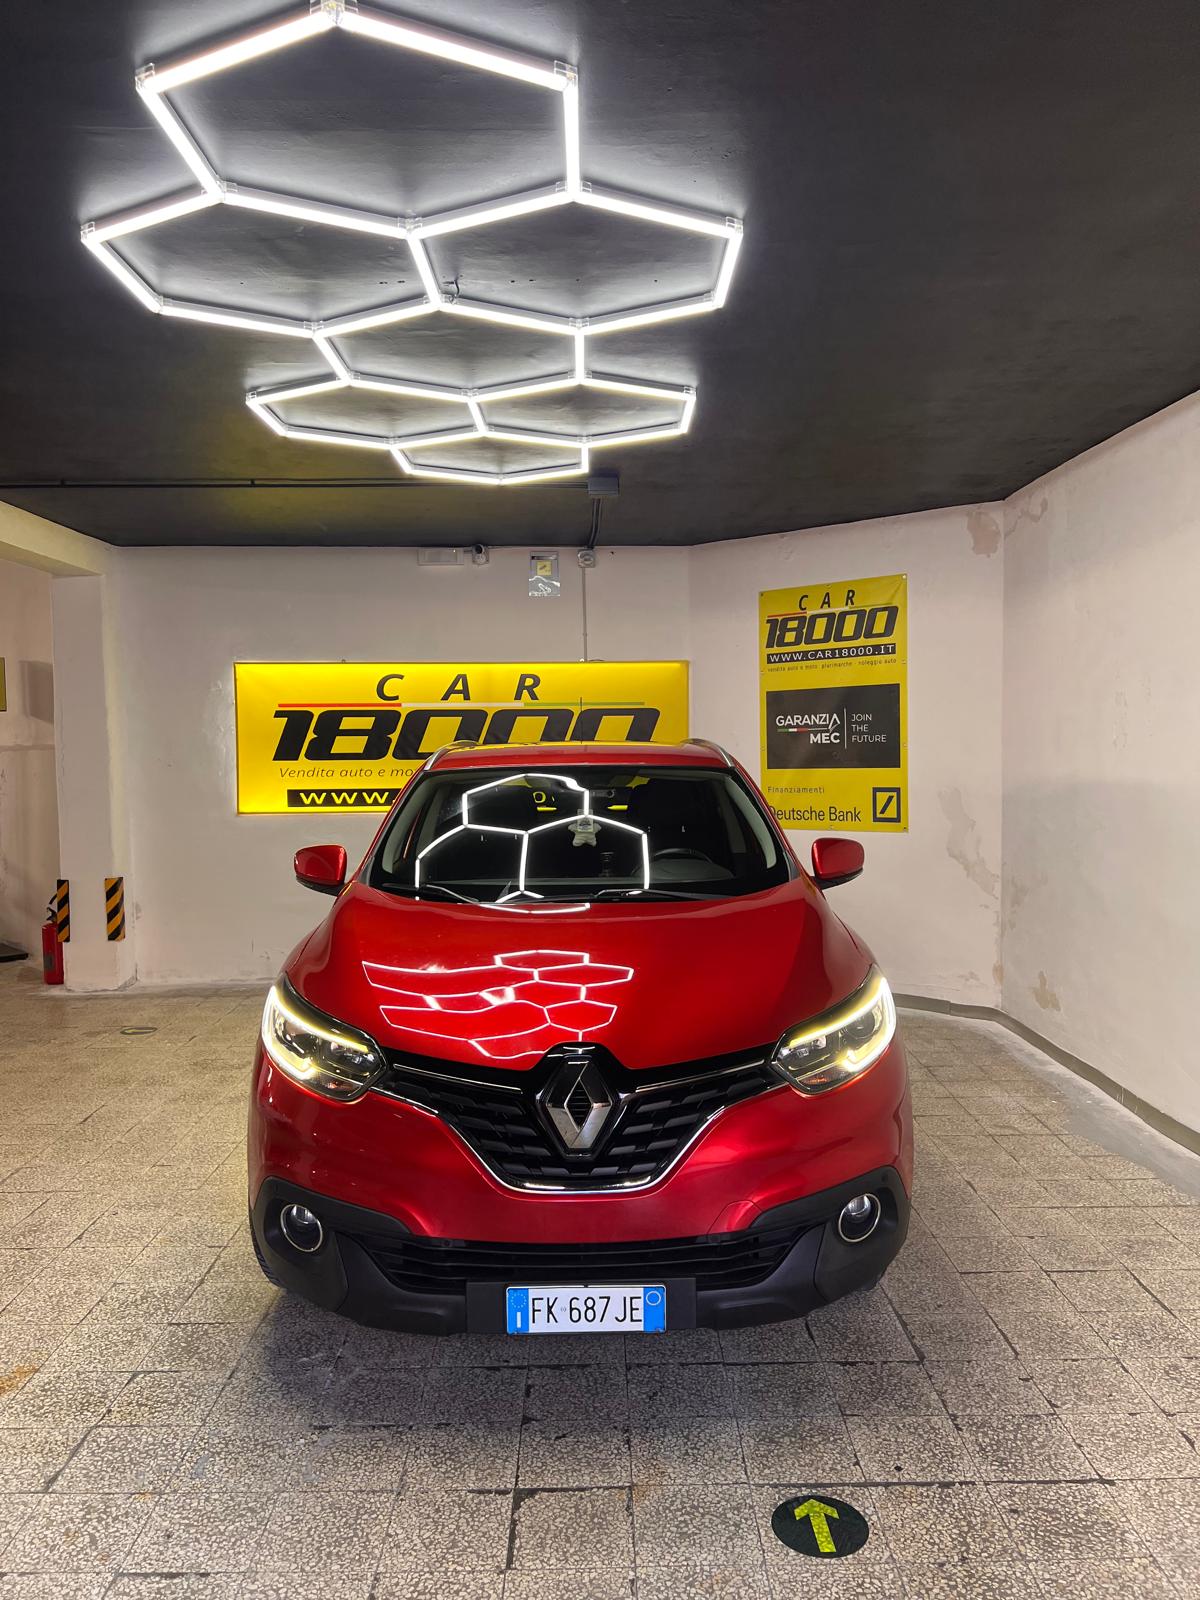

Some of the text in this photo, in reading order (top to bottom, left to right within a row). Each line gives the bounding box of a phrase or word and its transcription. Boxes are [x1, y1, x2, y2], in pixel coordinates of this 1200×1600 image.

[765, 605, 899, 649] 18000
[769, 644, 895, 663] WWW.CAR18000.IT
[775, 713, 841, 730] GARANZIA
[851, 713, 873, 722] JOIN
[851, 724, 869, 732] THE
[809, 732, 841, 744] MEC
[851, 734, 887, 743] FUTURE
[279, 767, 335, 778] Vendita
[339, 768, 373, 778] auto
[377, 768, 386, 777] e
[767, 786, 825, 794] Finanziamenti
[828, 806, 862, 822] Bank
[531, 1296, 643, 1324] FK 687 JE
